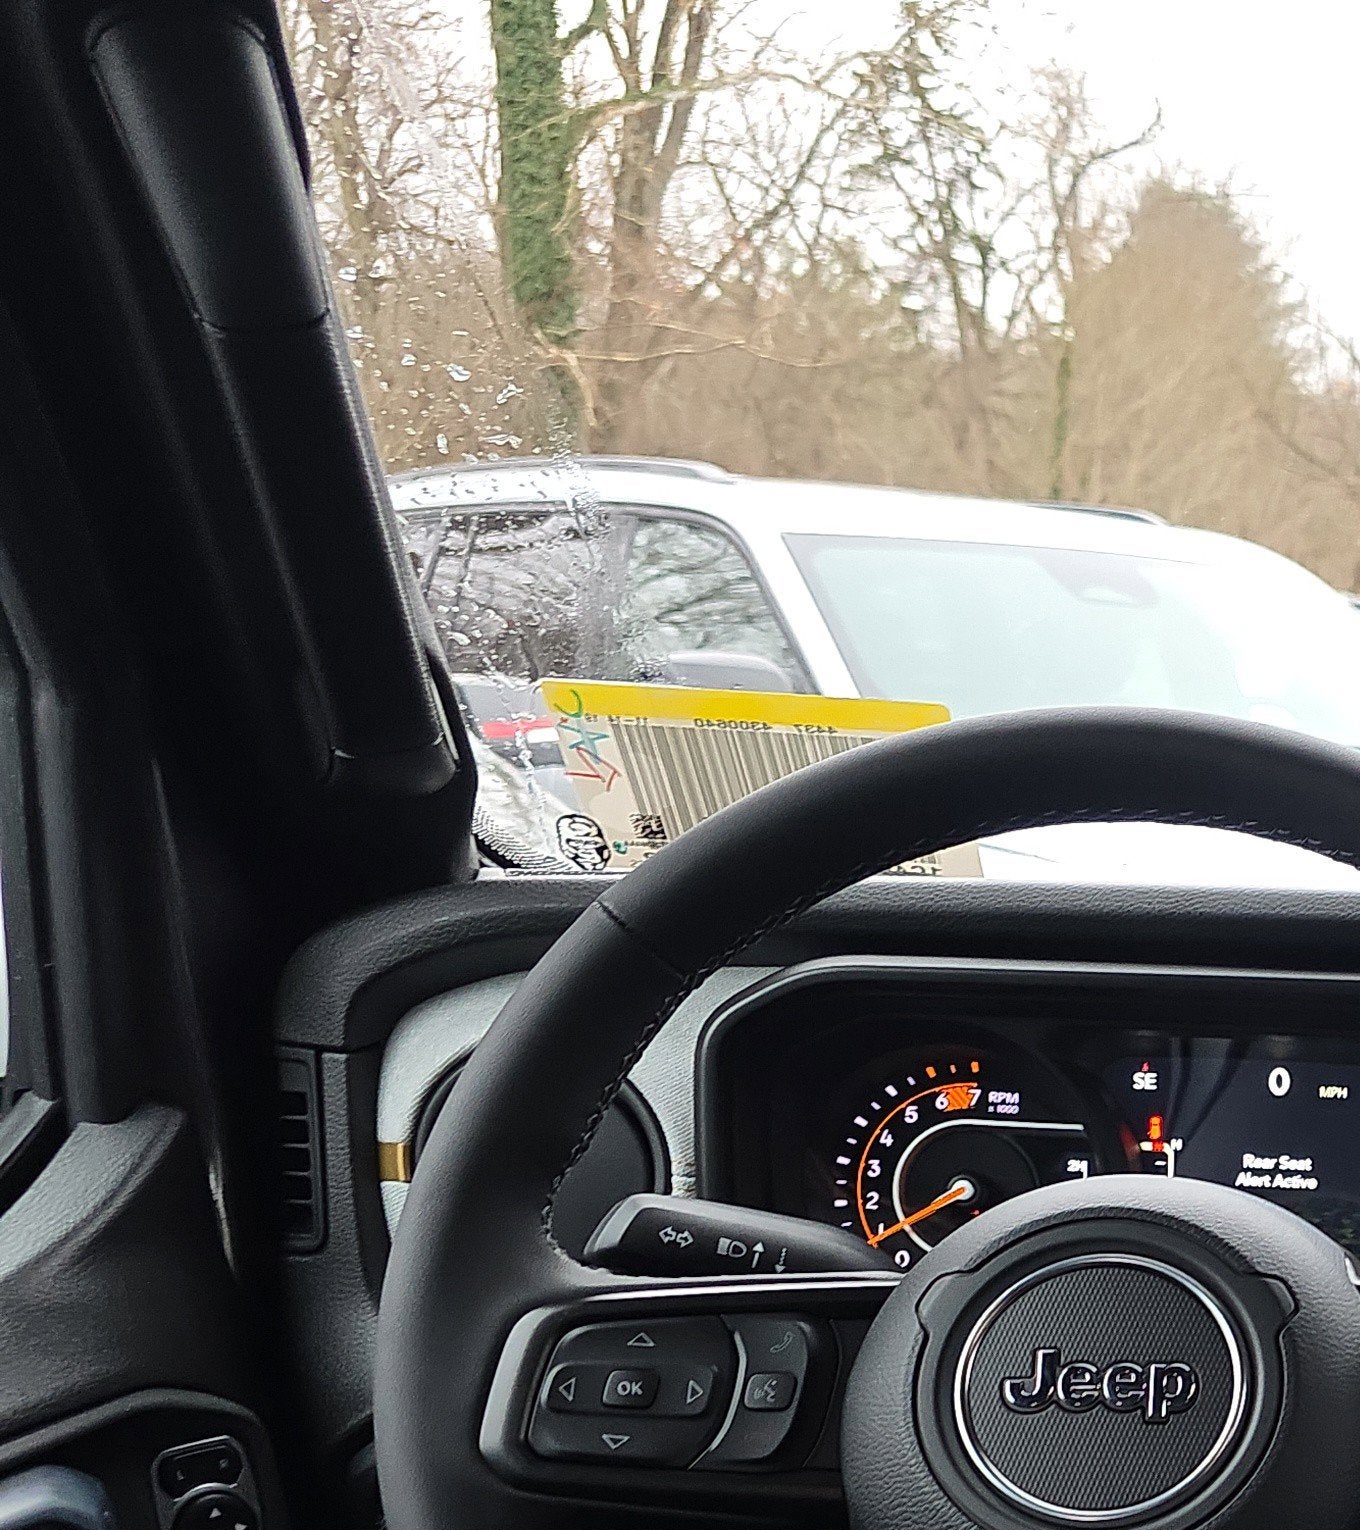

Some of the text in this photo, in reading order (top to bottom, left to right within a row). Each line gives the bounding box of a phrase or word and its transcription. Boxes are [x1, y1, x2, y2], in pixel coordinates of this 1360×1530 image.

[1131, 1071, 1158, 1091] SE
[1267, 1065, 1292, 1097] 0
[934, 1092, 949, 1111] 6
[968, 1088, 982, 1108] 7
[988, 1090, 1020, 1105] RPM
[1318, 1085, 1348, 1100] MPH
[904, 1105, 919, 1124] 5
[879, 1127, 894, 1147] 4
[866, 1159, 882, 1178] 3
[1242, 1153, 1313, 1172] Rear Seat
[1235, 1172, 1319, 1190] Alert Active
[865, 1191, 880, 1210] 2
[894, 1249, 911, 1268] 0
[616, 1380, 645, 1398] OK
[1003, 1347, 1199, 1424] Jeep
